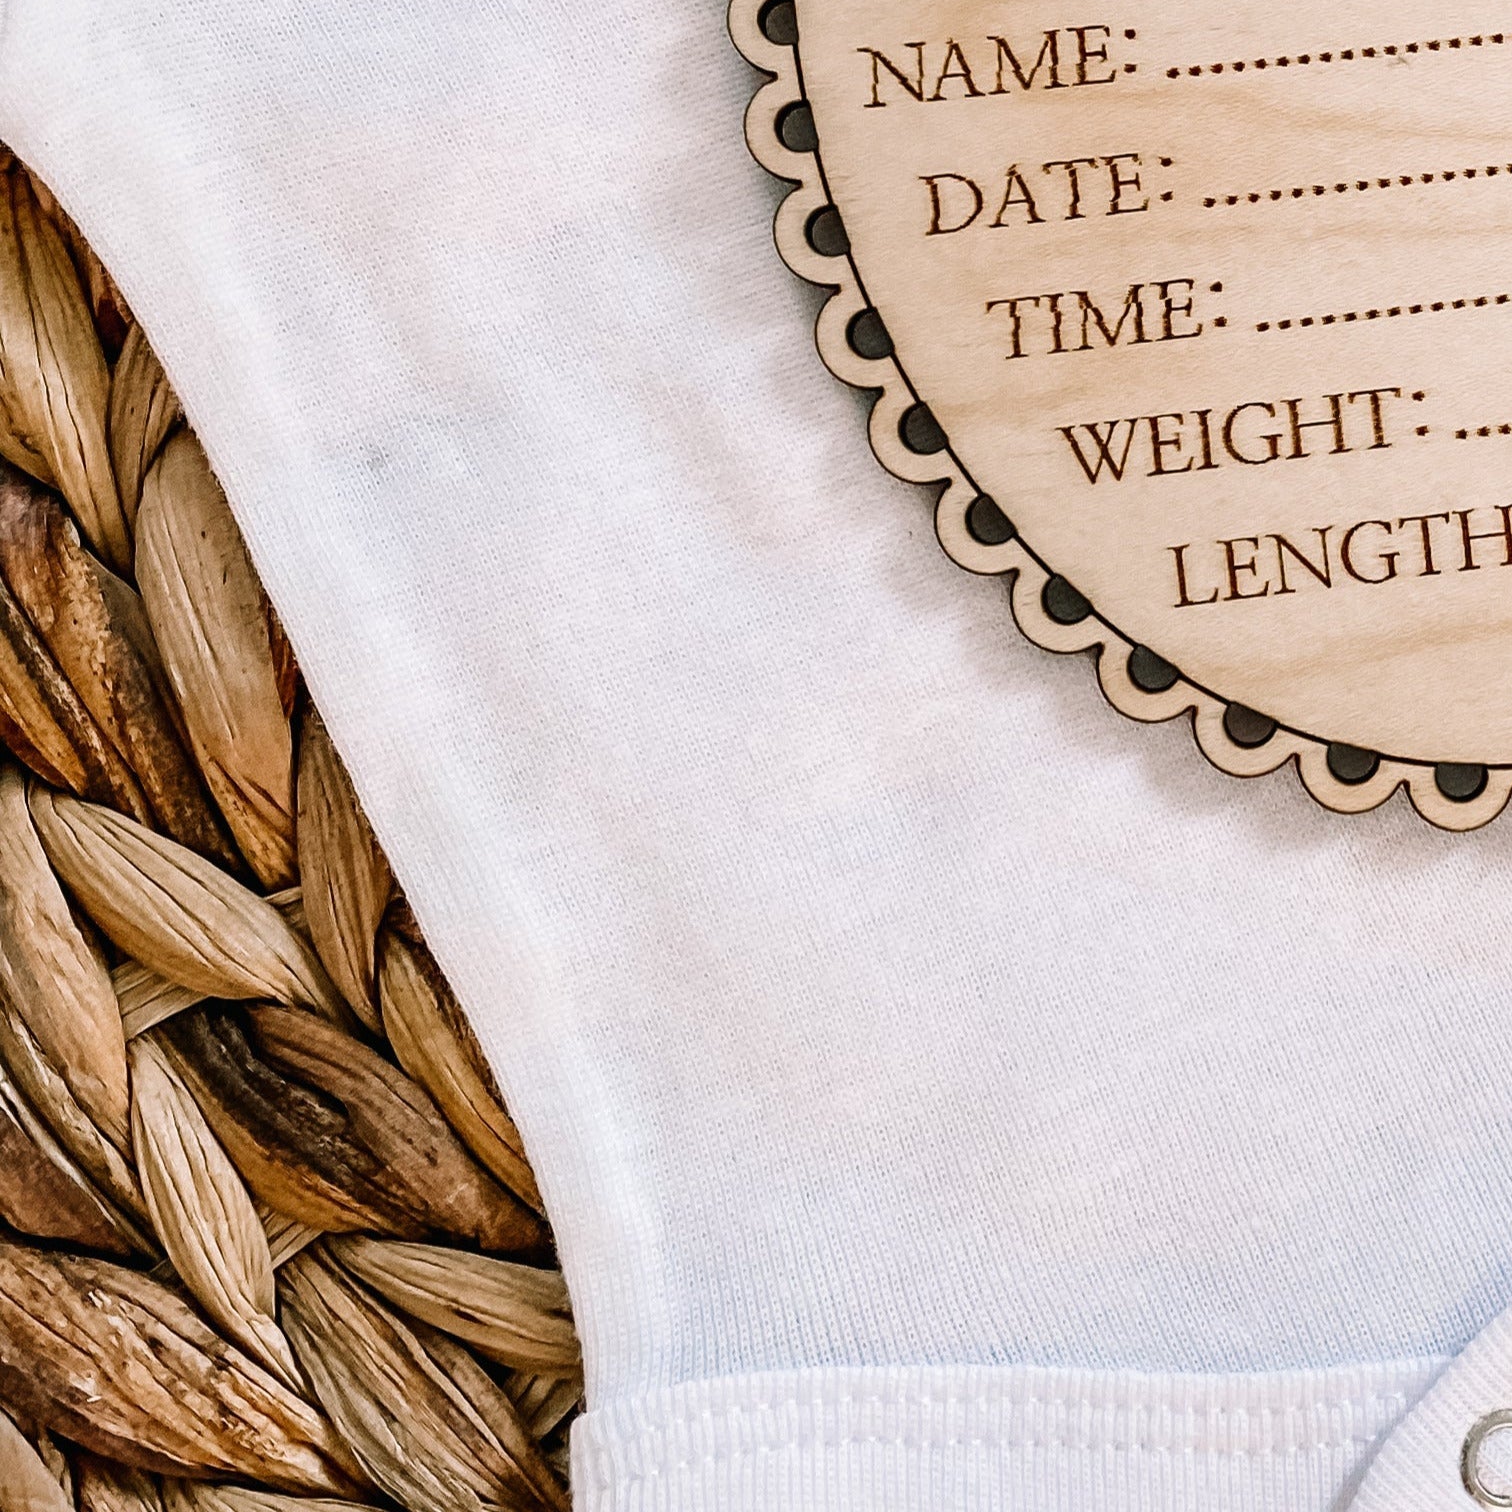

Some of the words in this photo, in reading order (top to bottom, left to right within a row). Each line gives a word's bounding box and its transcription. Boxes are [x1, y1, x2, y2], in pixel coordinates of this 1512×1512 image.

[857, 23, 1141, 109] NAME:
[919, 152, 1176, 237] DATE:
[986, 276, 1229, 361] TIME:
[1056, 386, 1432, 486] WEIGHT:
